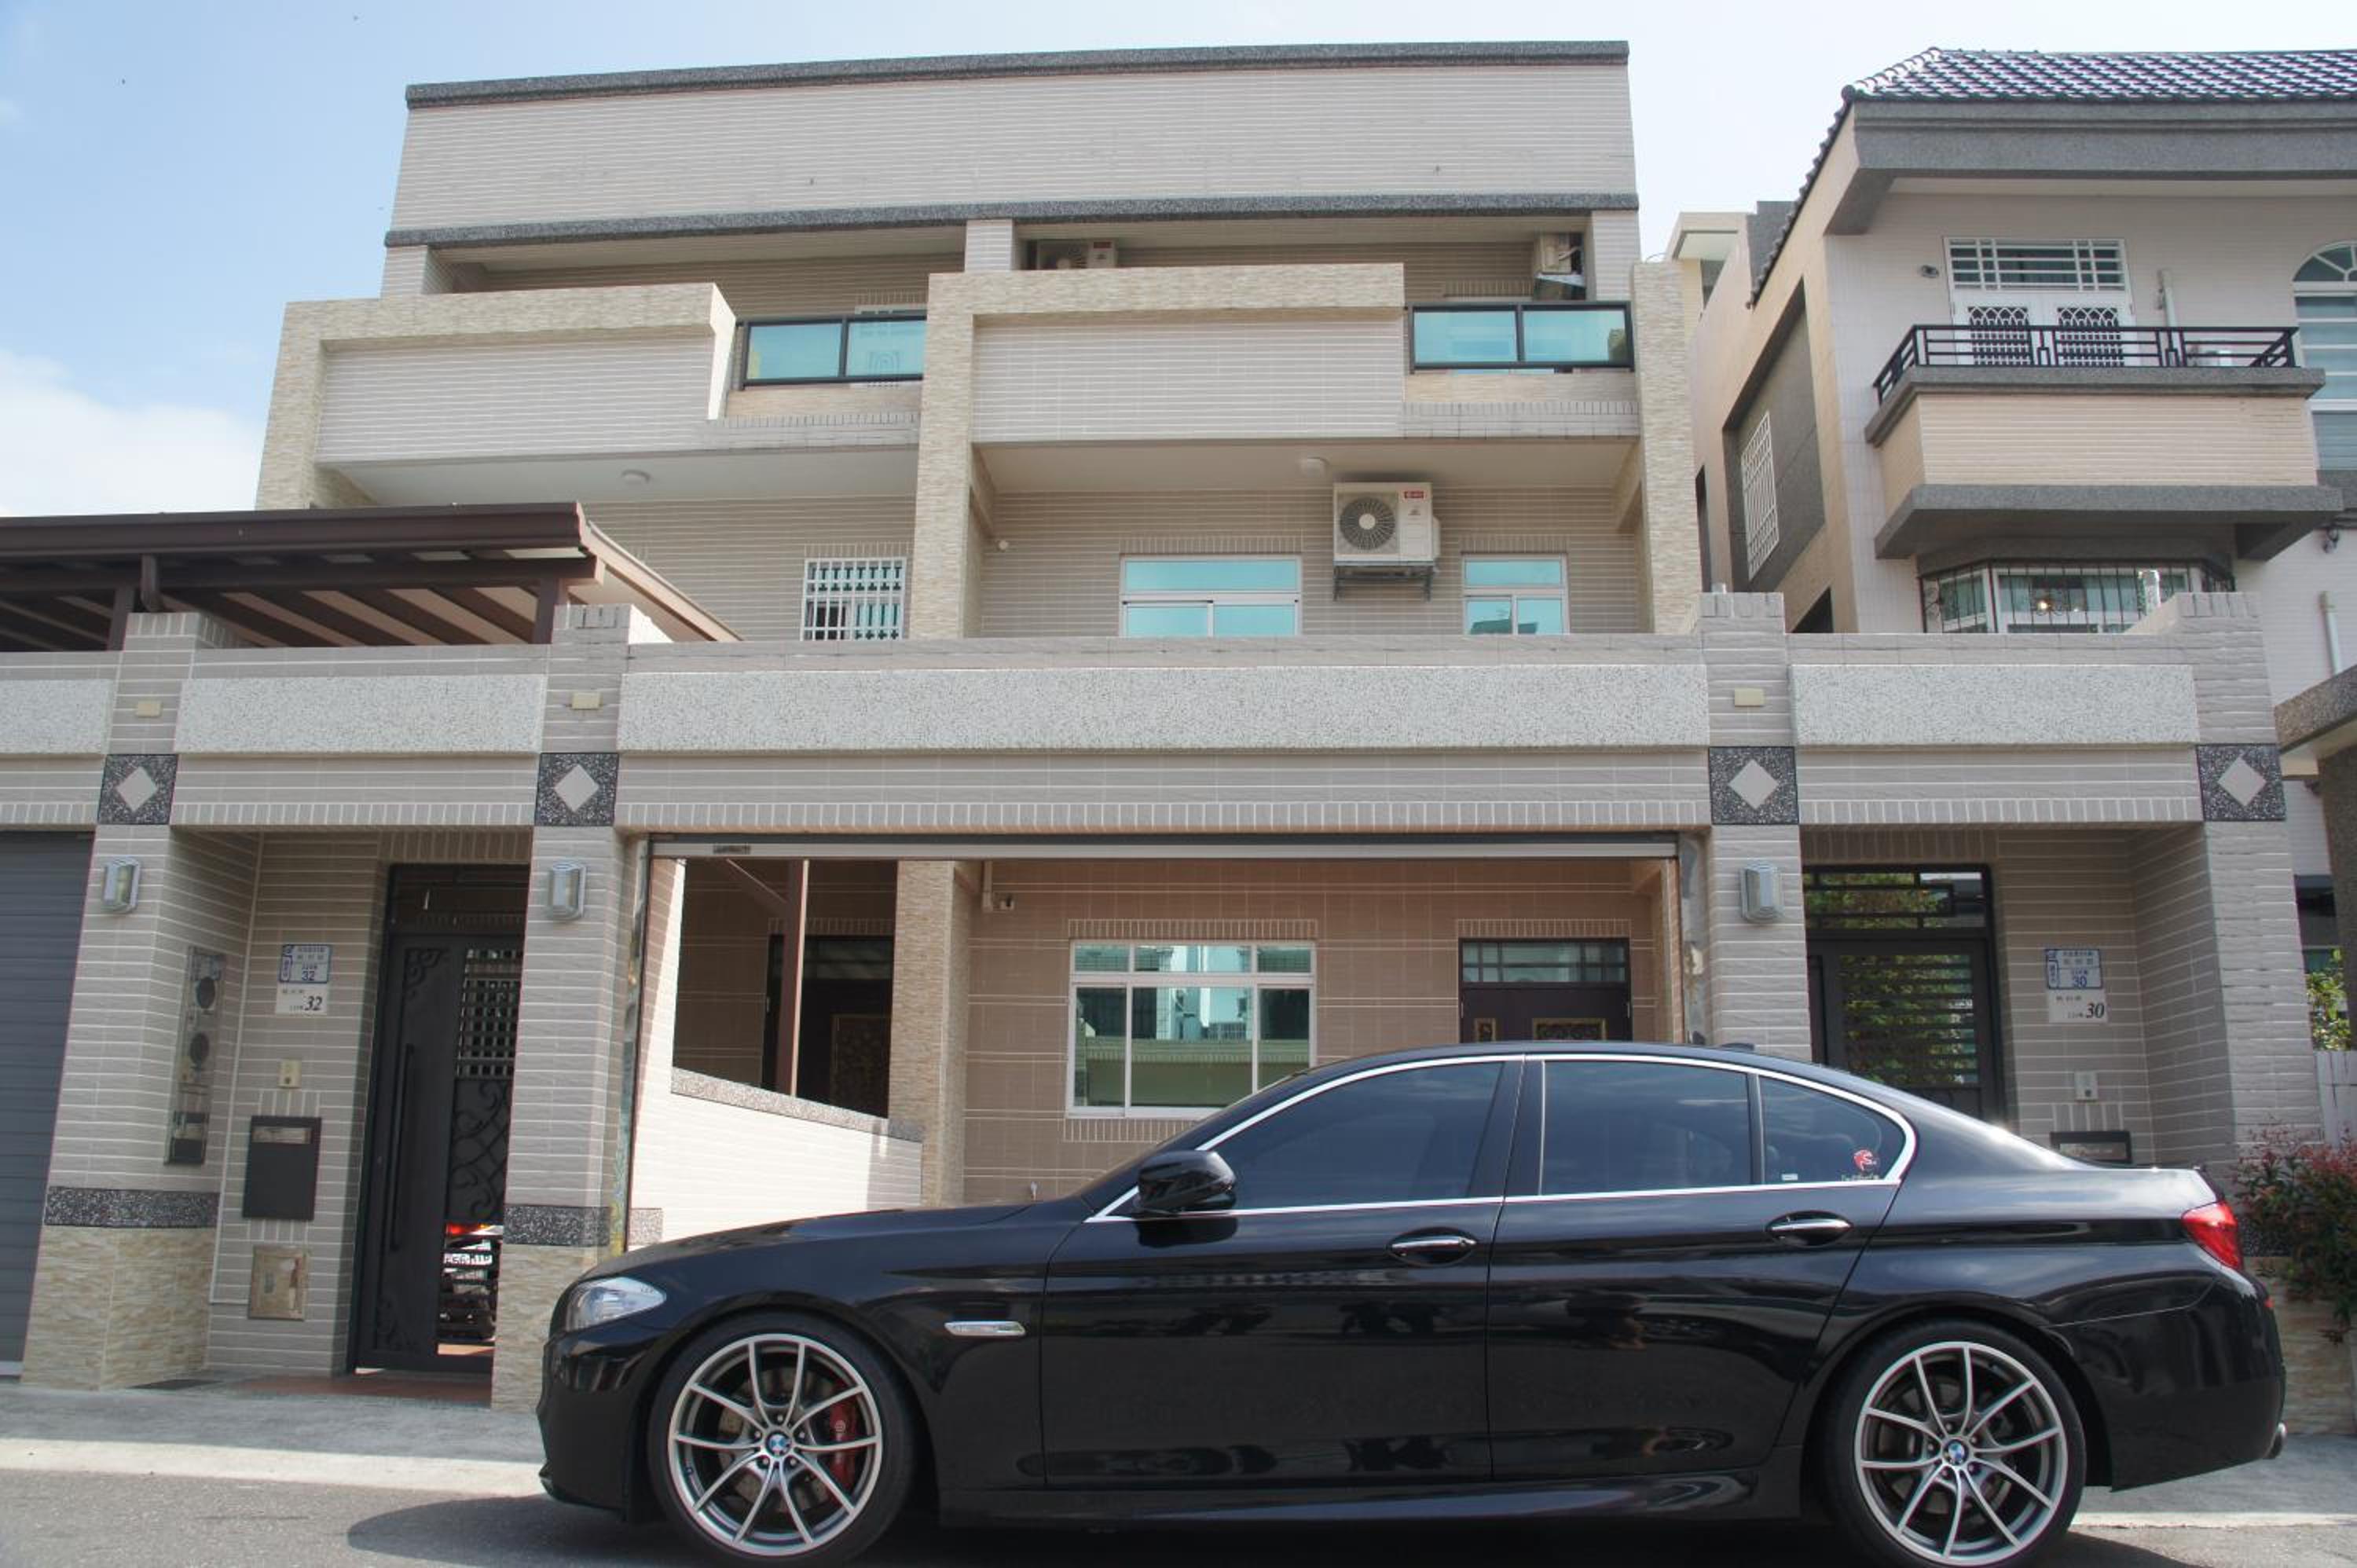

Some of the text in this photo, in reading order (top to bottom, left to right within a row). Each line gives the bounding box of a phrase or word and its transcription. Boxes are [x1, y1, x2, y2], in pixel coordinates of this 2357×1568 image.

[302, 970, 315, 981] 32
[2072, 975, 2088, 987] 30
[304, 995, 323, 1011] 32
[2086, 1002, 2105, 1019] 30
